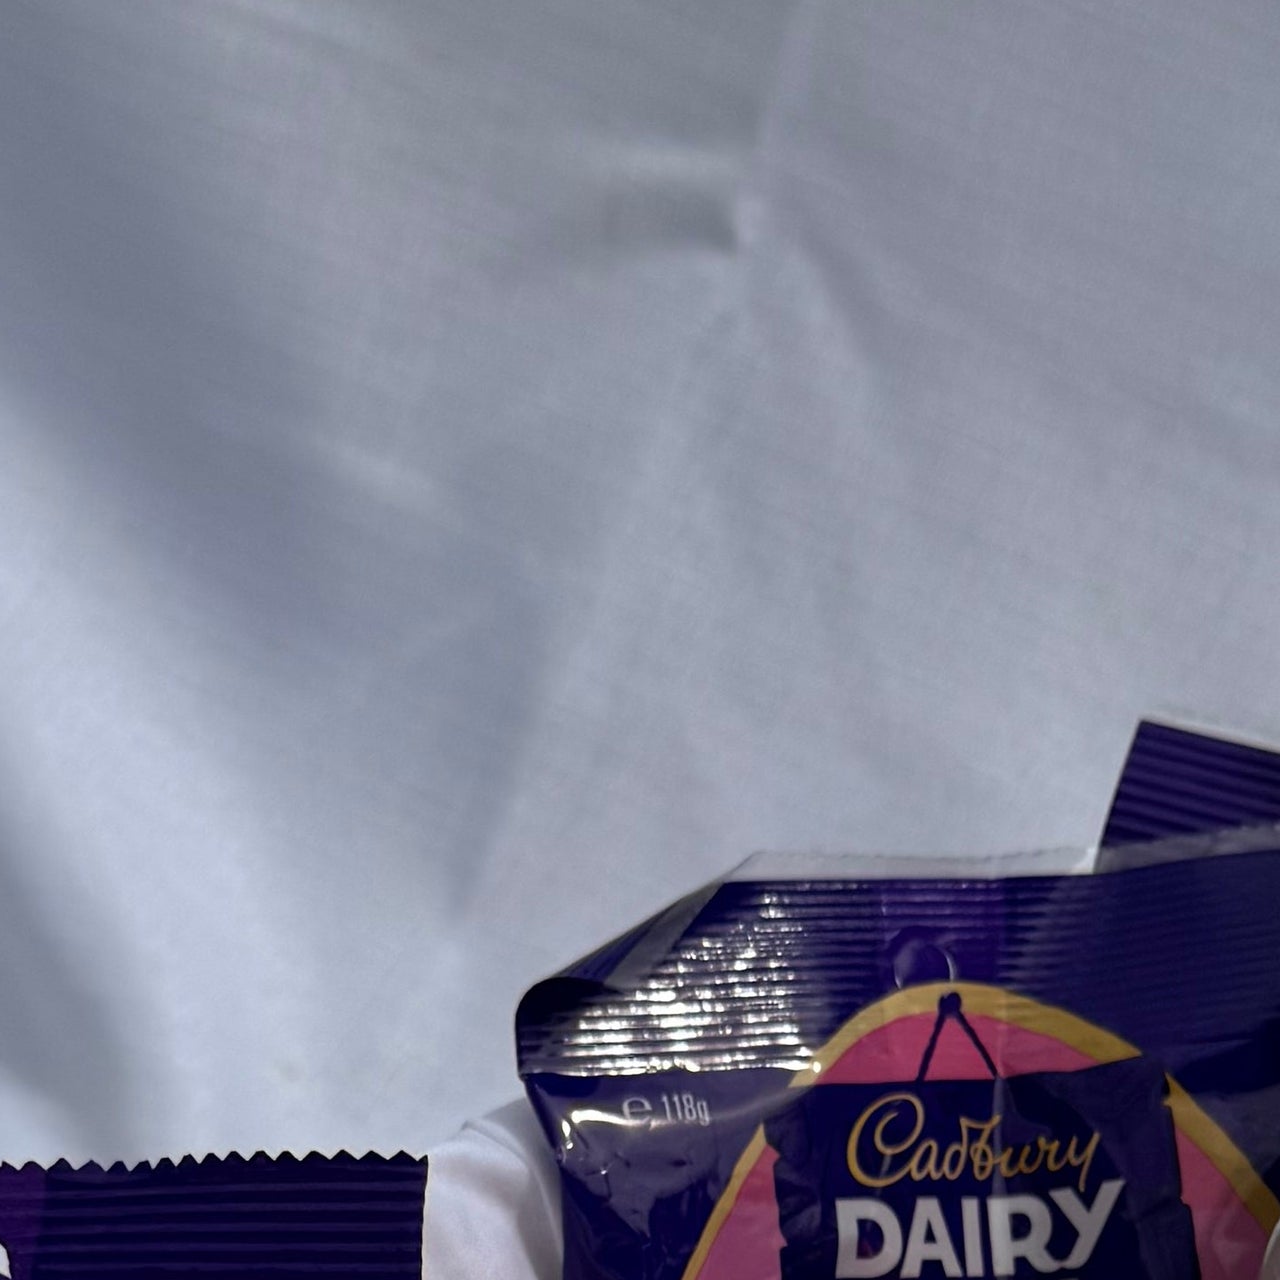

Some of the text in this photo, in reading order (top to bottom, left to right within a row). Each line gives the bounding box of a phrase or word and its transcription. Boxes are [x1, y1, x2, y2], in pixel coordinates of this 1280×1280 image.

[661, 1093, 710, 1127] 118g
[846, 1092, 1101, 1192] Cadbury
[834, 1179, 1126, 1280] DAIRY
